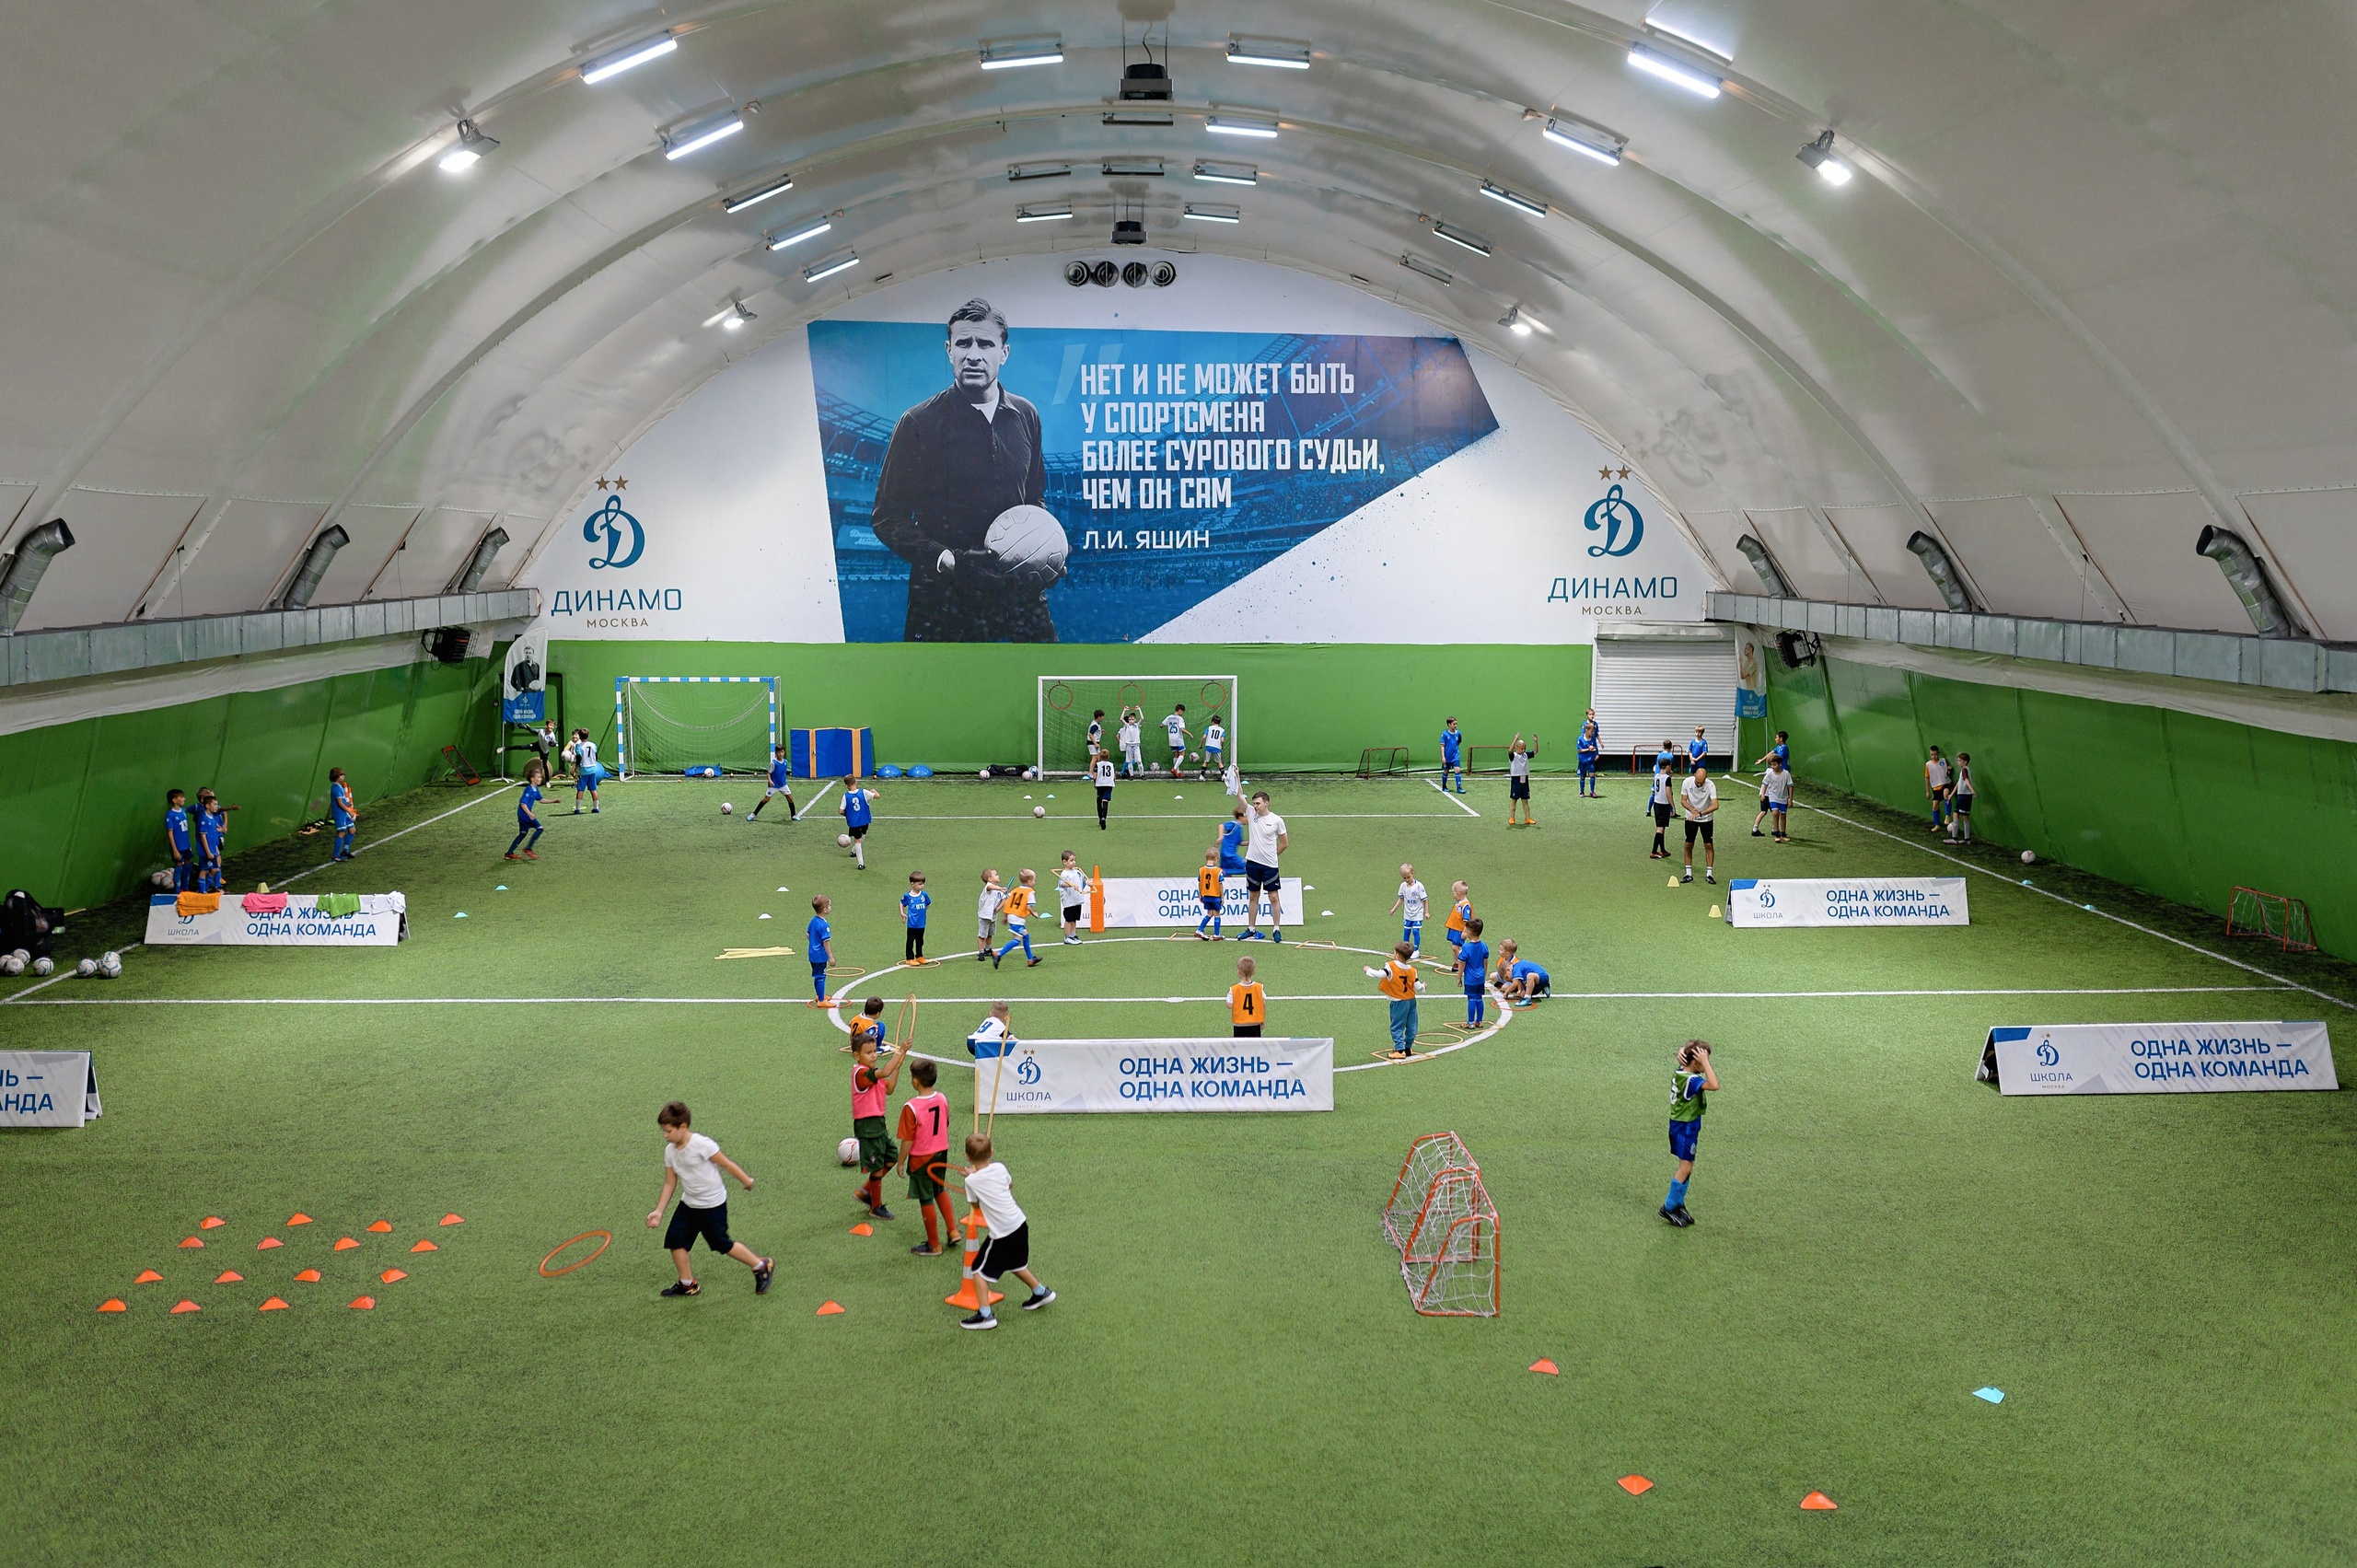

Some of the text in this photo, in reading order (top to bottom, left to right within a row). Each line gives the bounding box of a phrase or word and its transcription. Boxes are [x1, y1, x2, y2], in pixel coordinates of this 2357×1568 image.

[1081, 363, 1354, 395] НЕТ И НЕ МОЖЕТ БЫТЬ
[1081, 401, 1265, 434] У СПОРТСМЕНА
[1083, 438, 1385, 474] БОЛЕЕ СУРОВОГО СУДЬИ,
[1083, 477, 1232, 509] ЧЕМ ОН САМ
[1083, 529, 1210, 550] Л.И. ЯШИН
[1548, 576, 1678, 603] ДИНАМО
[552, 588, 682, 616] ДИНАМО
[1582, 606, 1643, 616] МОСКВА
[586, 618, 649, 628] МОСКВА
[1211, 729, 1220, 739] 10
[586, 747, 591, 757] 7
[1101, 765, 1111, 777] 13
[1655, 779, 1660, 792] 9
[852, 797, 861, 811] 3
[1205, 873, 1212, 890] 3
[1010, 892, 1023, 909] 14
[1826, 890, 1869, 903] ОДНА
[1873, 889, 1925, 901] ЖИЗНЬ
[1159, 905, 1202, 918] ОДНА
[1828, 905, 1950, 919] ОДНА КОМАНДА
[247, 923, 377, 937] ОДНА КОМАНДА
[1399, 975, 1409, 993] 7
[1243, 993, 1253, 1015] 4
[977, 1021, 993, 1033] 9
[2131, 1040, 2192, 1059] ОДНА
[2196, 1039, 2271, 1055] ЖИЗНЬ
[1119, 1058, 1184, 1078] ОДНА
[1190, 1056, 1271, 1074] ЖИЗНЬ
[2135, 1060, 2309, 1081] ОДНА КОМАНДА
[2030, 1073, 2073, 1082] ШКОЛА
[1006, 1091, 1051, 1101] ШКОЛА
[1120, 1079, 1306, 1101] ОДНА КОМАНДА
[0, 1093, 53, 1114] НДА
[928, 1105, 941, 1137] 7
